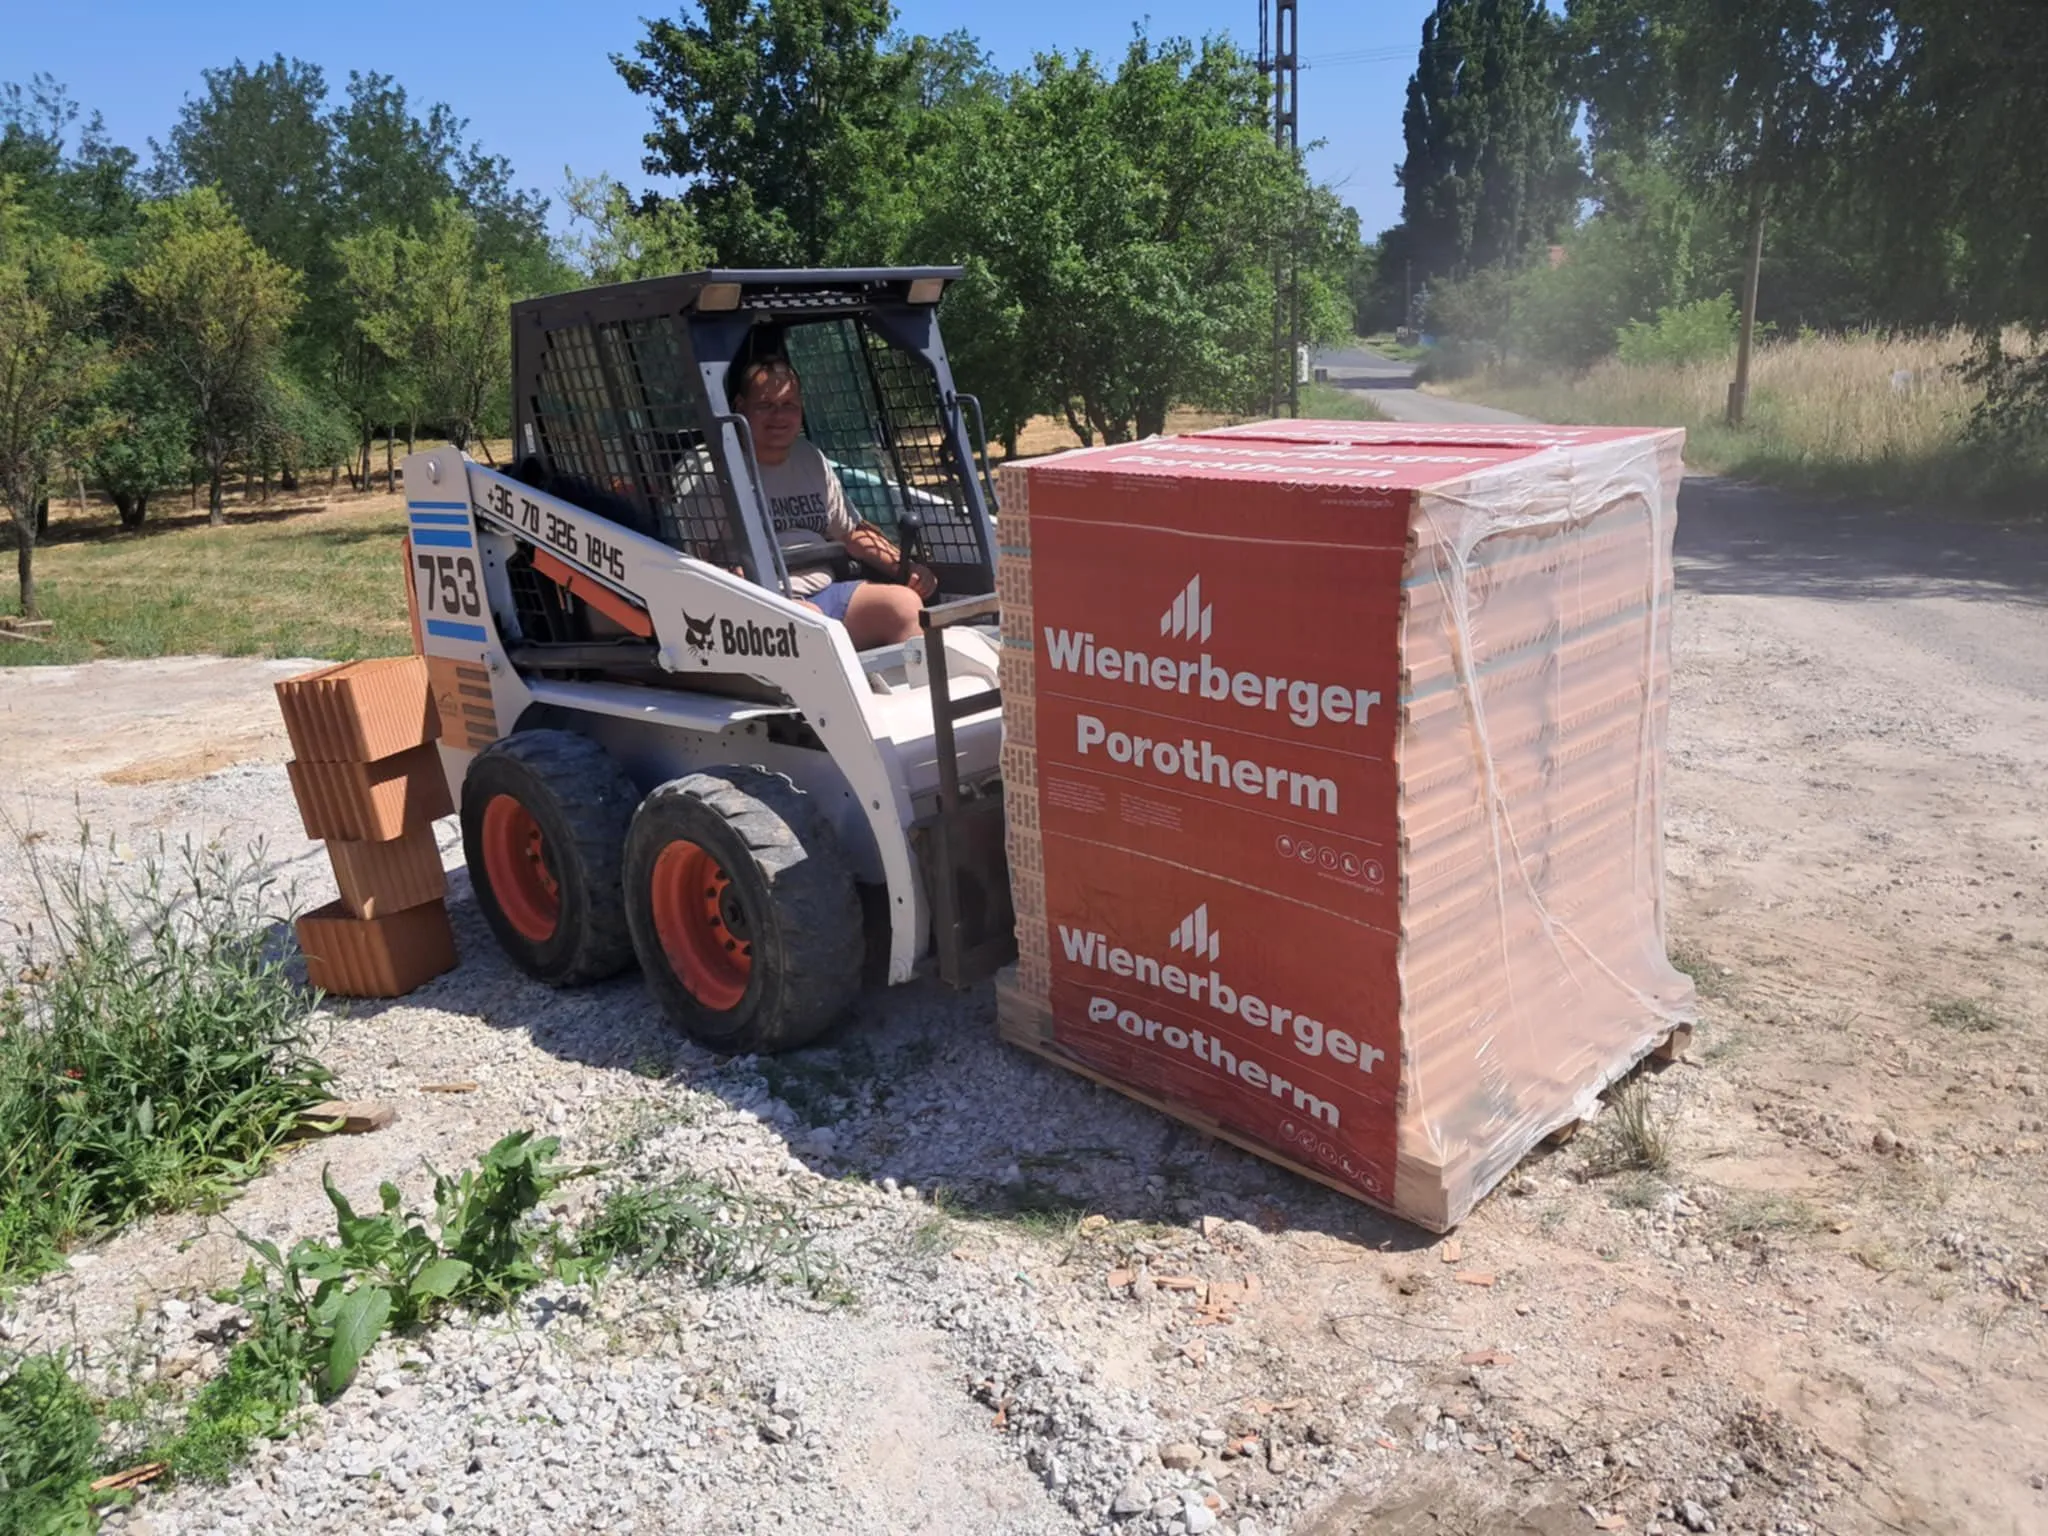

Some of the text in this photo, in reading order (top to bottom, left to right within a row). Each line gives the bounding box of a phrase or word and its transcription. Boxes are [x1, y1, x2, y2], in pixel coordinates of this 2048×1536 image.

[487, 484, 625, 581] +36 70 326 1845
[770, 492, 826, 517] ANGELES
[418, 554, 481, 617] 753
[720, 618, 799, 658] Bobcat
[1044, 626, 1381, 727] Wienerberger
[1076, 713, 1338, 815] Porotherm
[1058, 924, 1385, 1075] Wienerberger
[1088, 996, 1341, 1129] Porotherm
